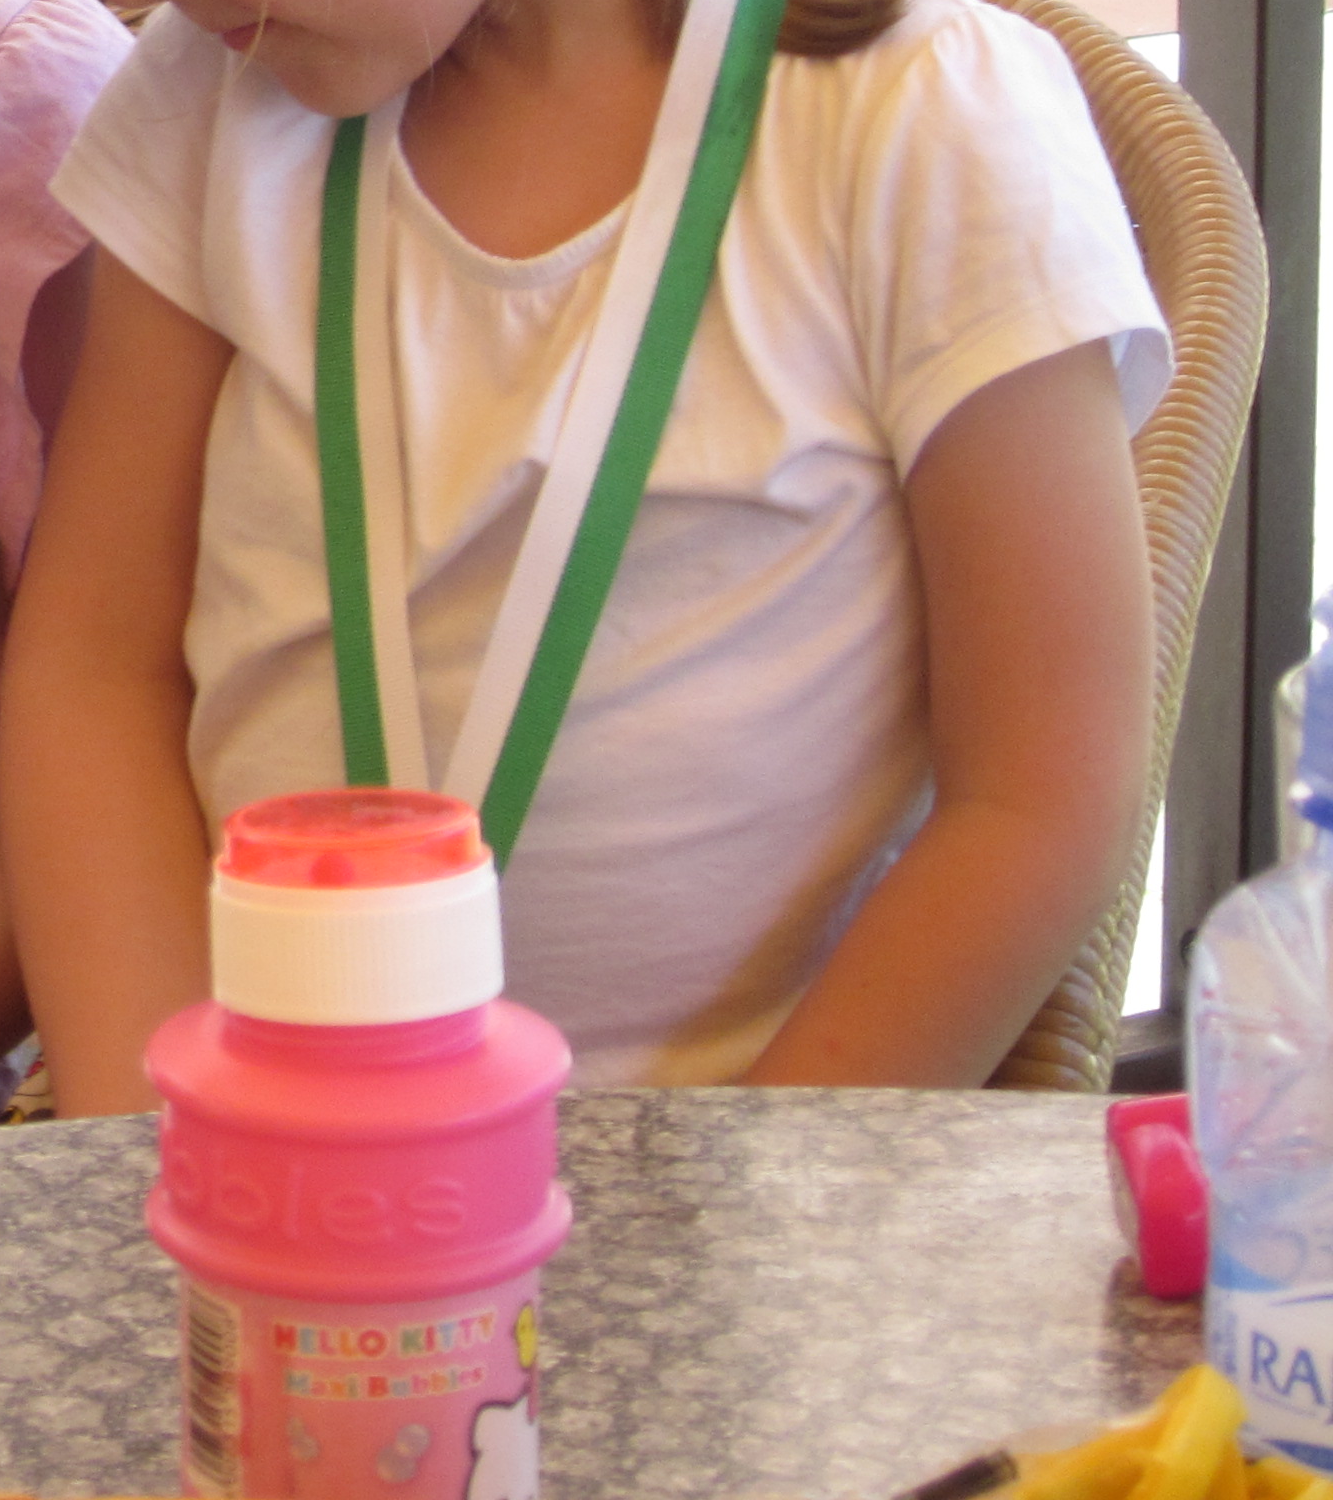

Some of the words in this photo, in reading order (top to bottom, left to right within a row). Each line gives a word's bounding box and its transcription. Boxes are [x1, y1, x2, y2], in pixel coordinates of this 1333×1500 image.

[273, 1322, 389, 1358] HELLO
[399, 1311, 495, 1357] KITTY
[285, 1368, 359, 1399] Maxi
[367, 1366, 485, 1399] Bubbles
[1250, 1329, 1333, 1426] RA
